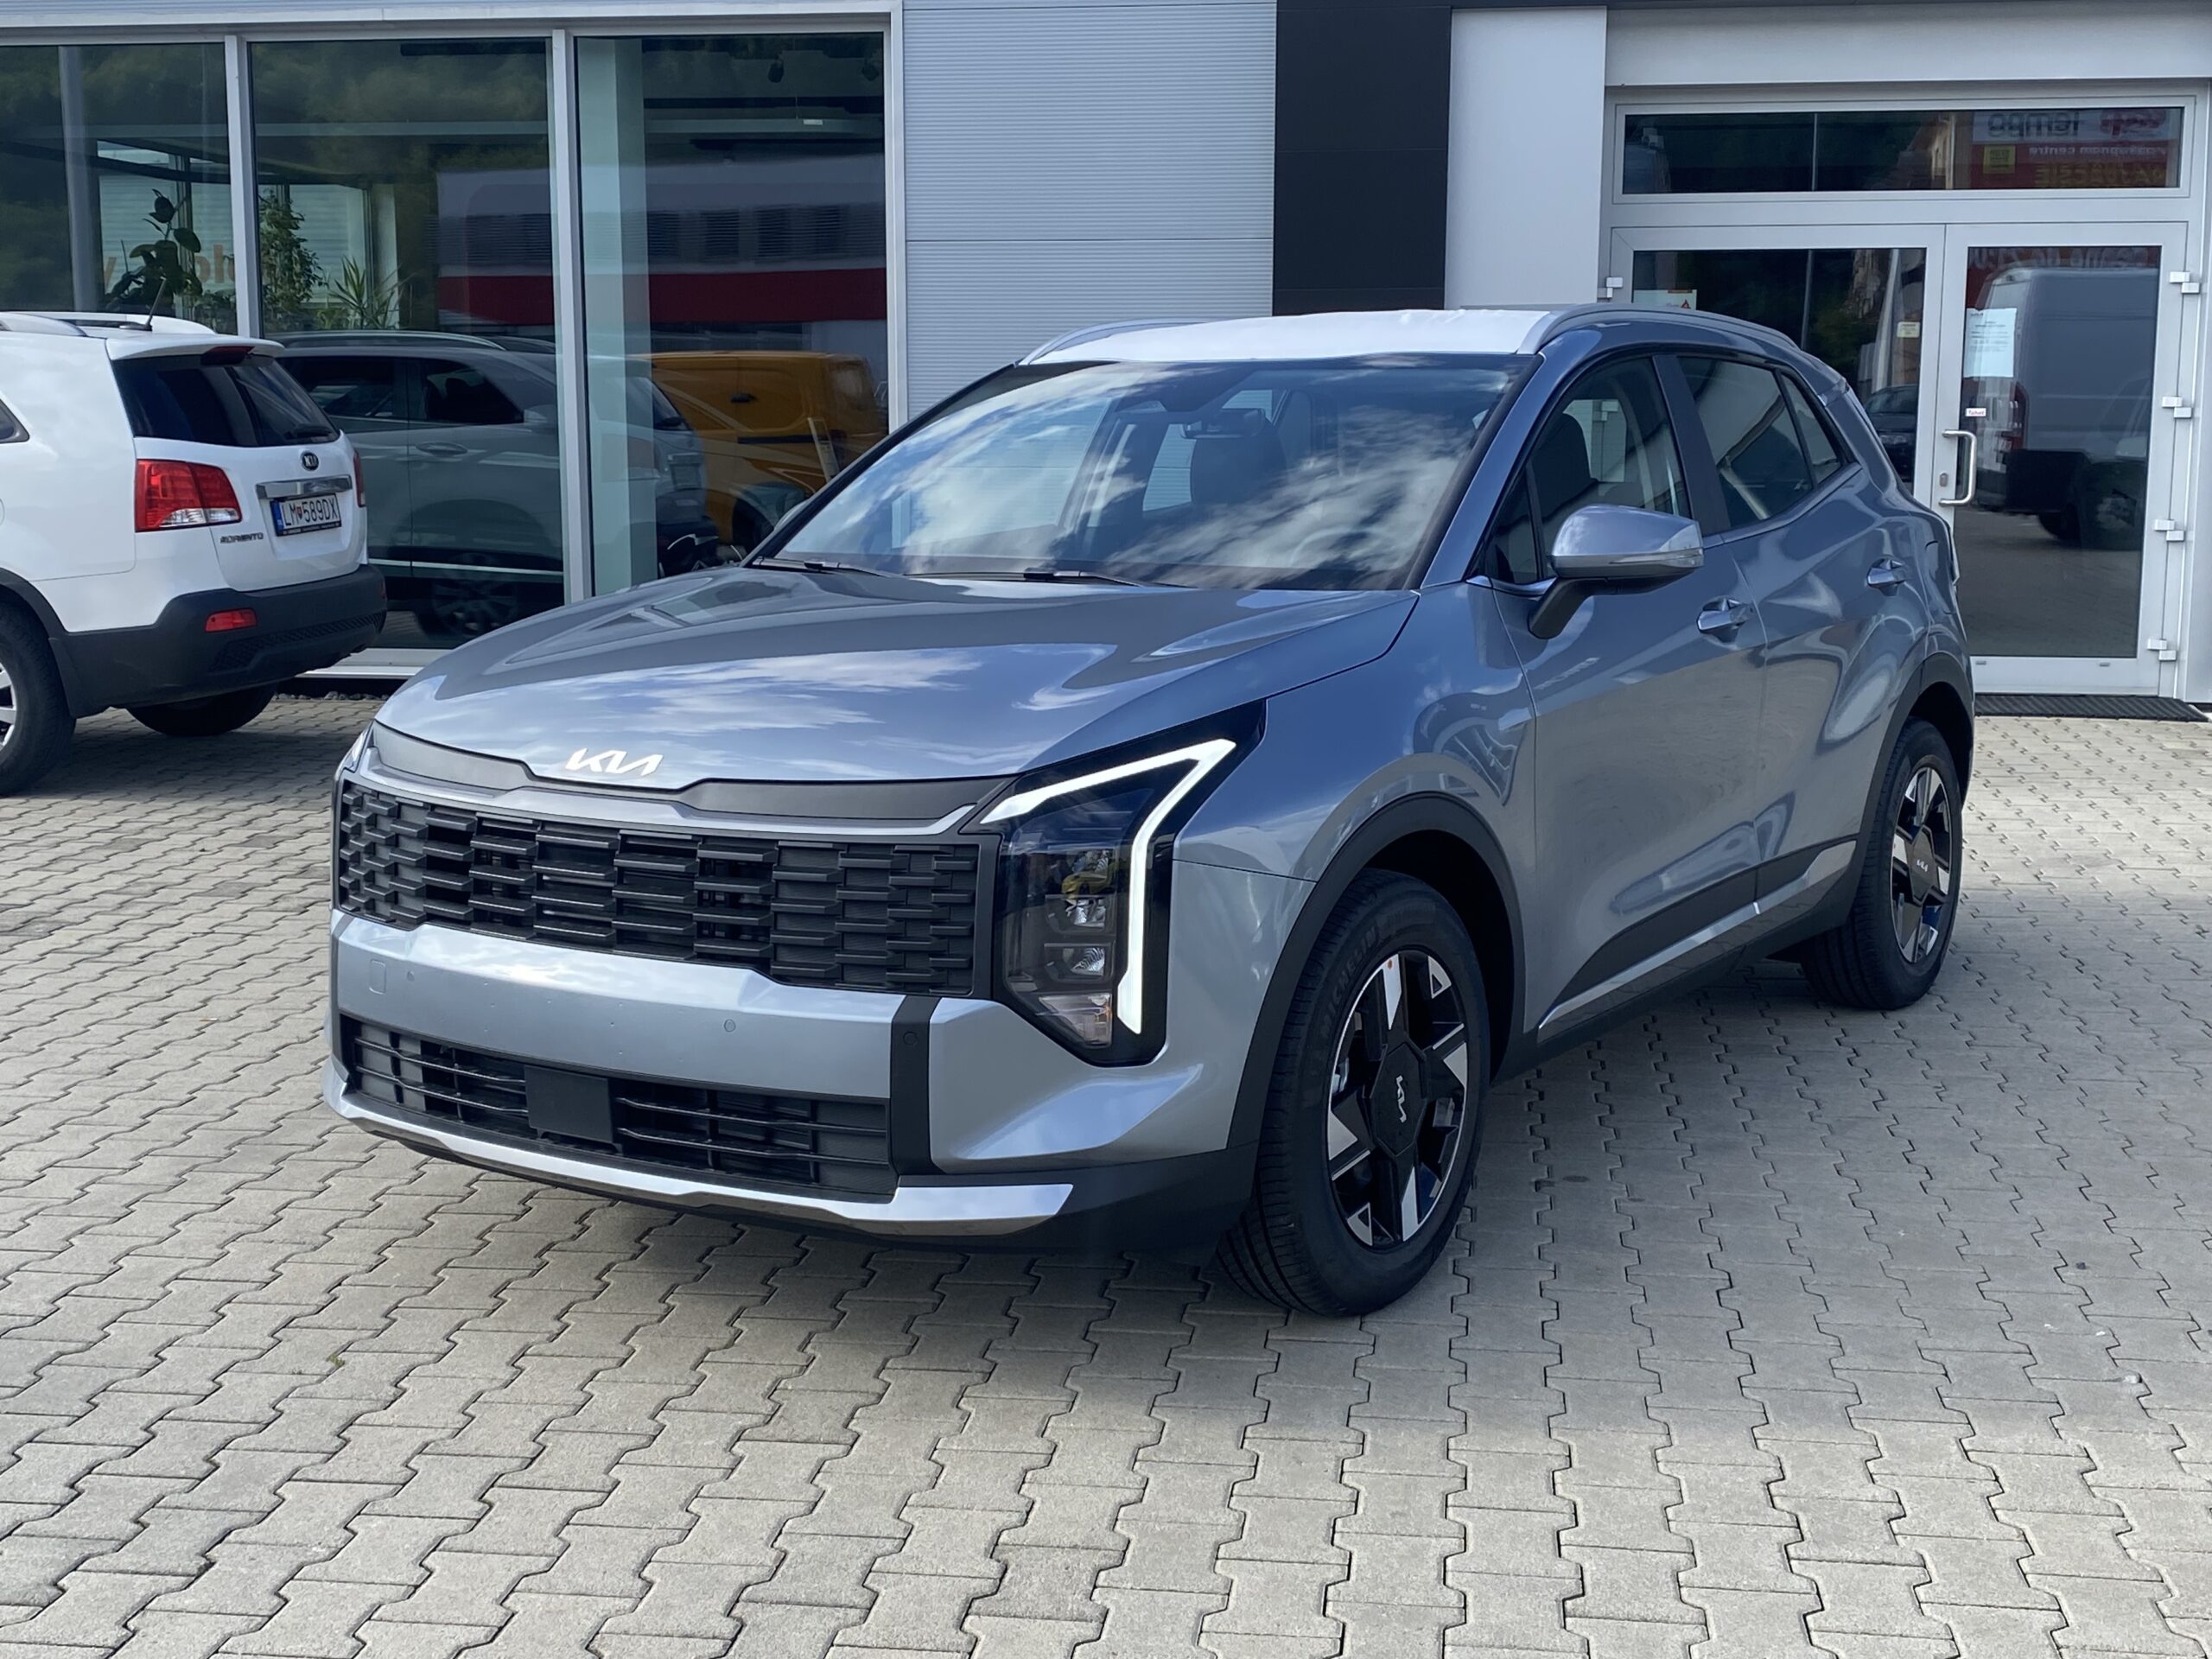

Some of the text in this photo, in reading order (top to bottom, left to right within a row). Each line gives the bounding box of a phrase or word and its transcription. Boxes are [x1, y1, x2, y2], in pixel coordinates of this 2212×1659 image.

[220, 532, 264, 543] SORENTO
[565, 748, 664, 777] KIA
[1319, 927, 1377, 1038] MICHELIN
